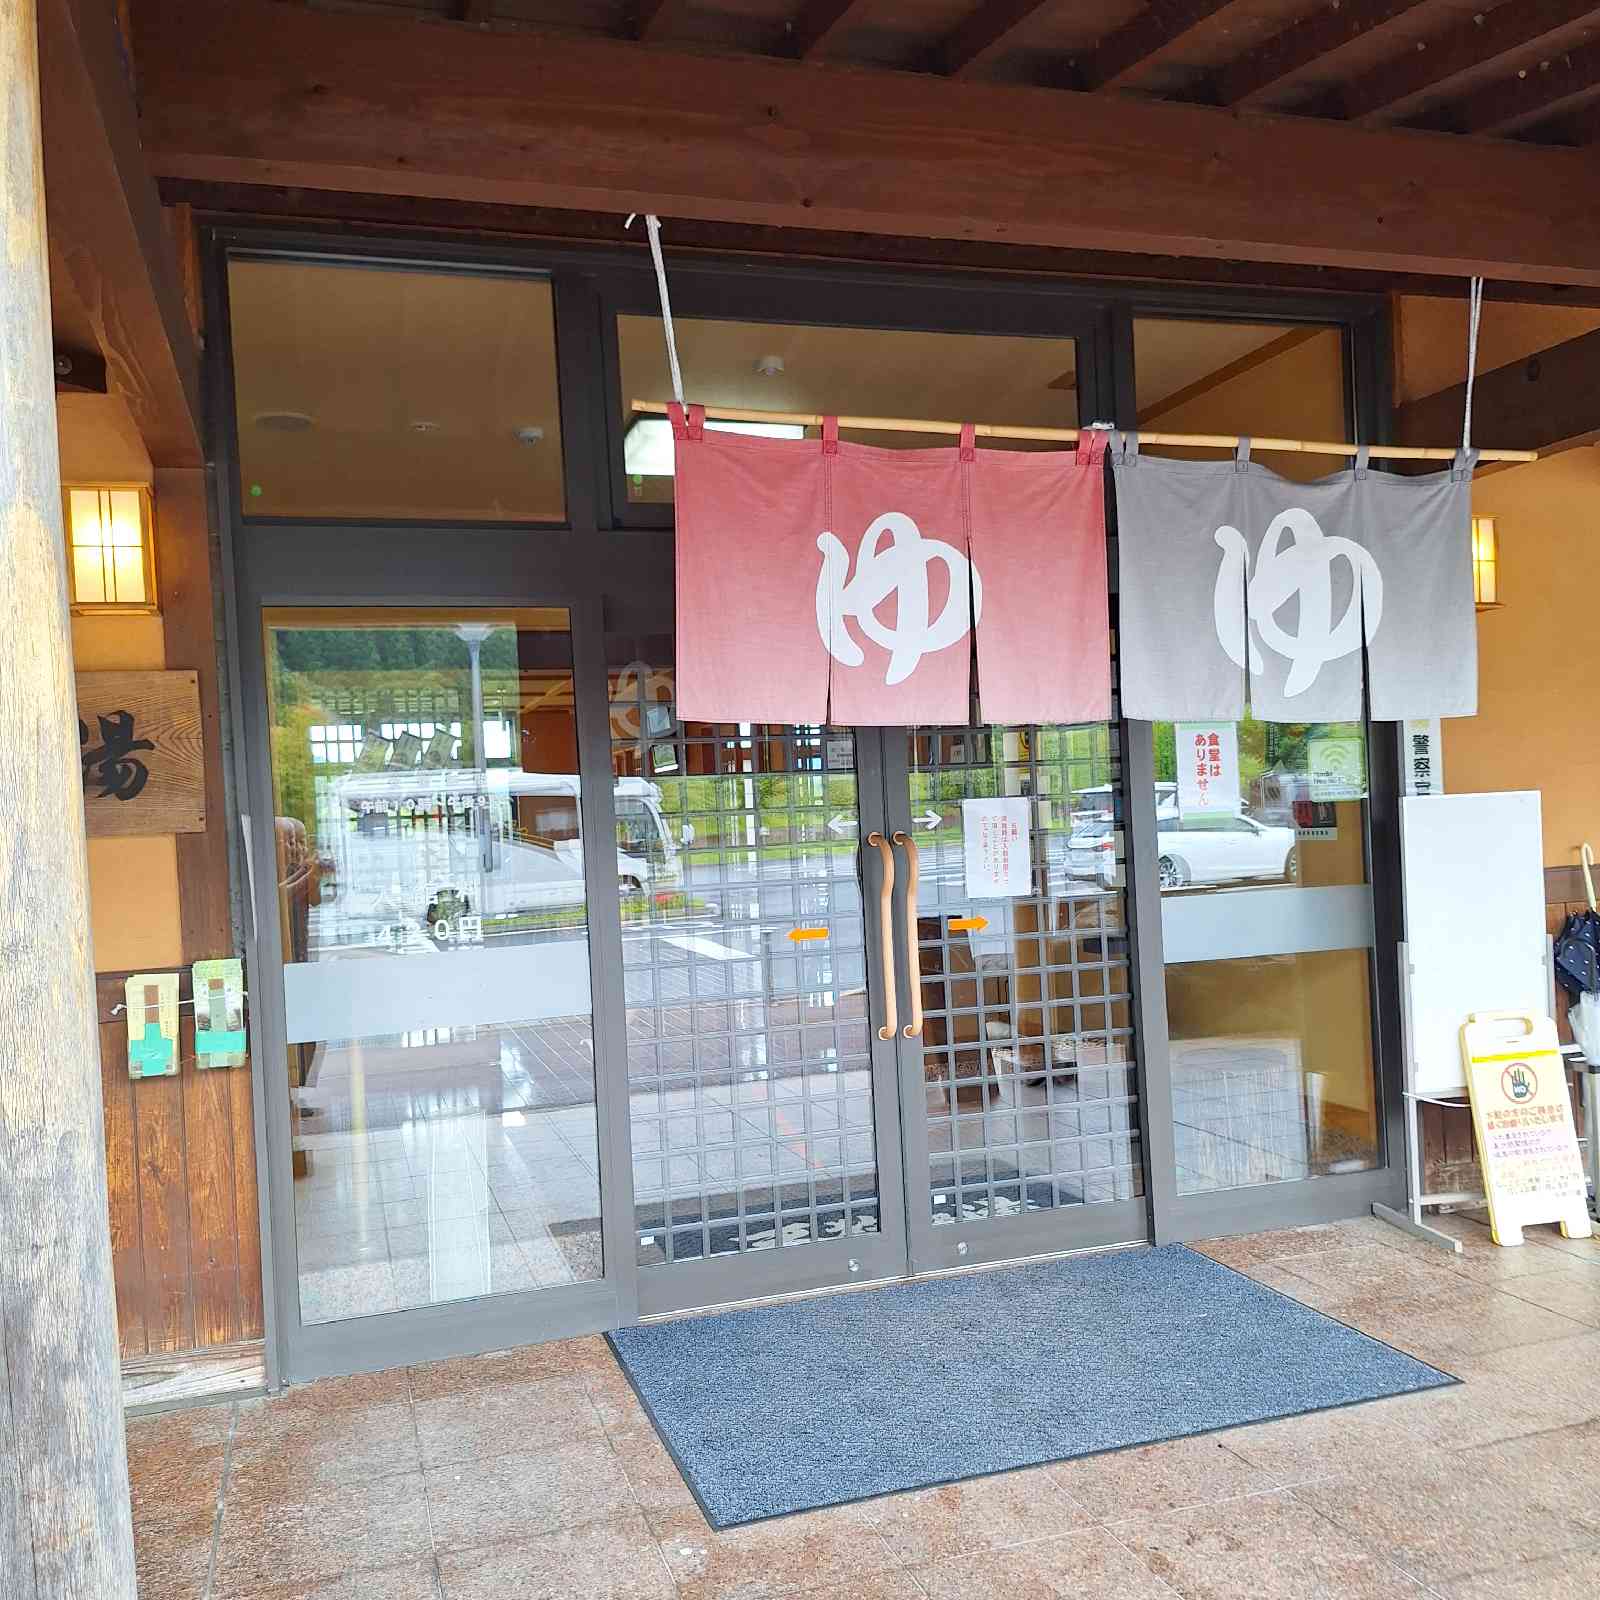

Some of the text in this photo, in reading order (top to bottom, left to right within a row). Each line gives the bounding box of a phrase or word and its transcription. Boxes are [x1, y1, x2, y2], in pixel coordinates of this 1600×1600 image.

[816, 511, 983, 685] ゆ
[1214, 507, 1384, 698] ゆ
[1195, 734, 1209, 806] ありません
[1208, 732, 1222, 777] 食堂は
